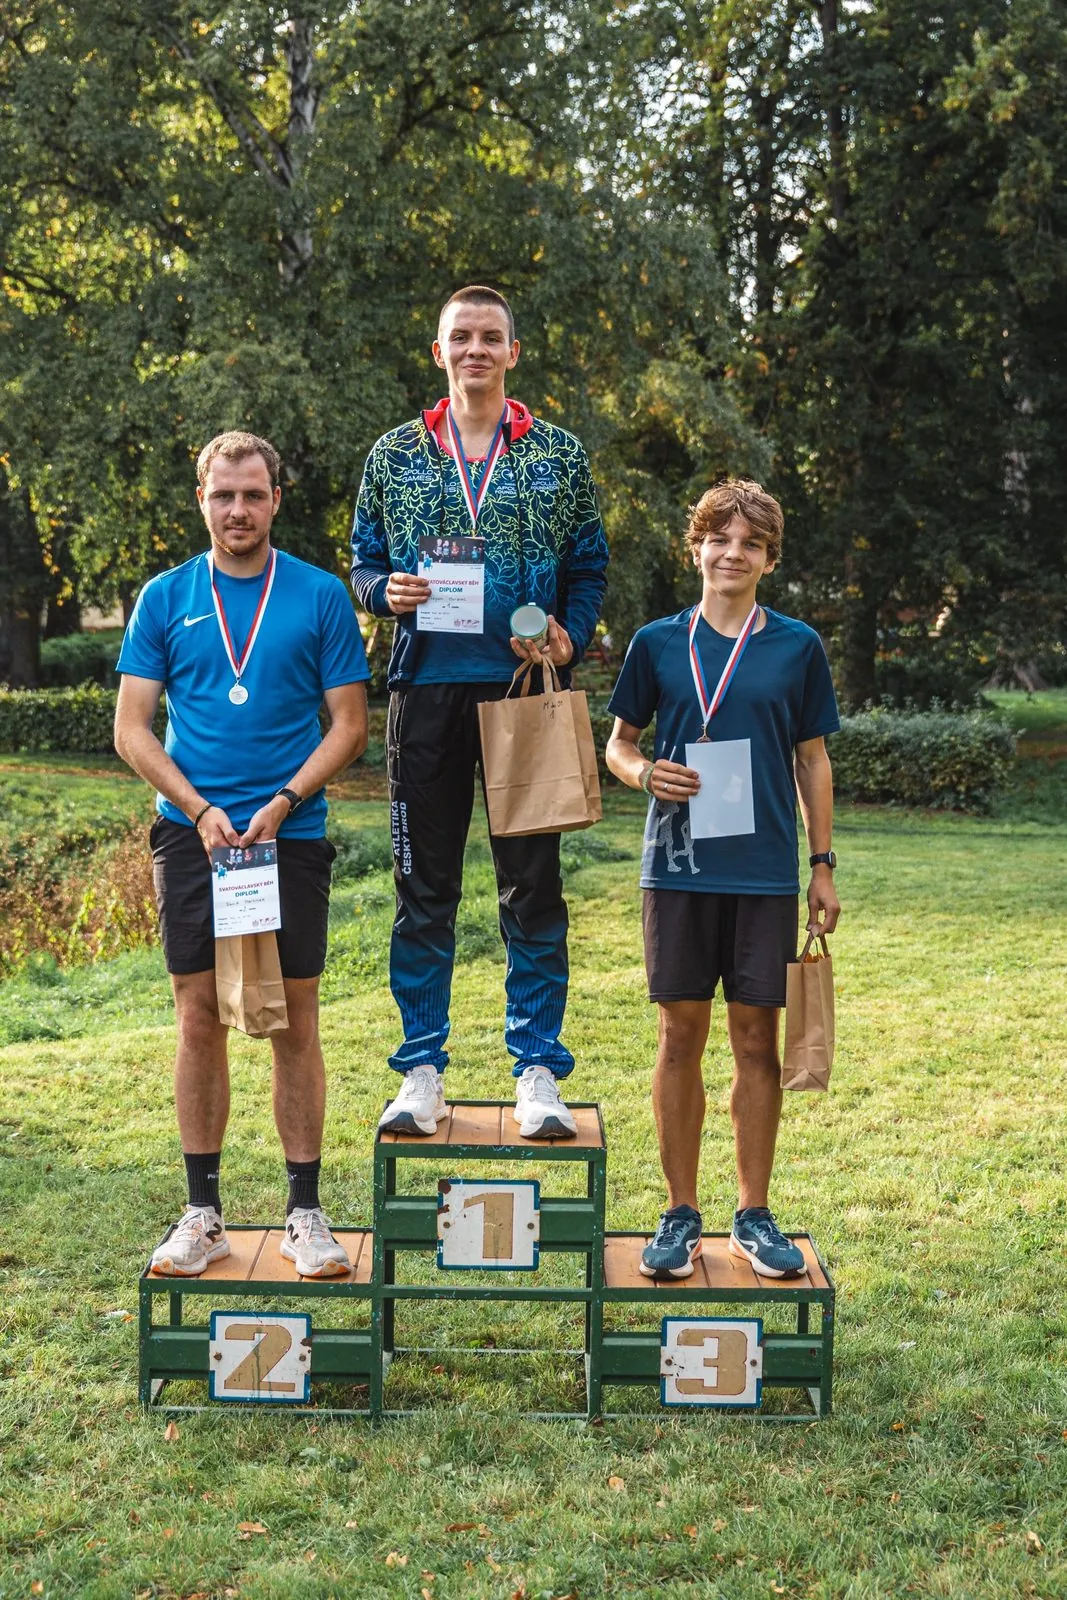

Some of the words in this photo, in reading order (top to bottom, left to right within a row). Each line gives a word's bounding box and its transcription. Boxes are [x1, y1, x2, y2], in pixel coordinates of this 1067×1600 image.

[402, 475, 432, 483] GAMES
[392, 801, 400, 856] ATLETIKA
[400, 802, 409, 833] BROD
[402, 836, 411, 875] ČESKÝ
[463, 1192, 514, 1259] 1
[224, 1323, 295, 1392] 2
[675, 1328, 748, 1396] 3
